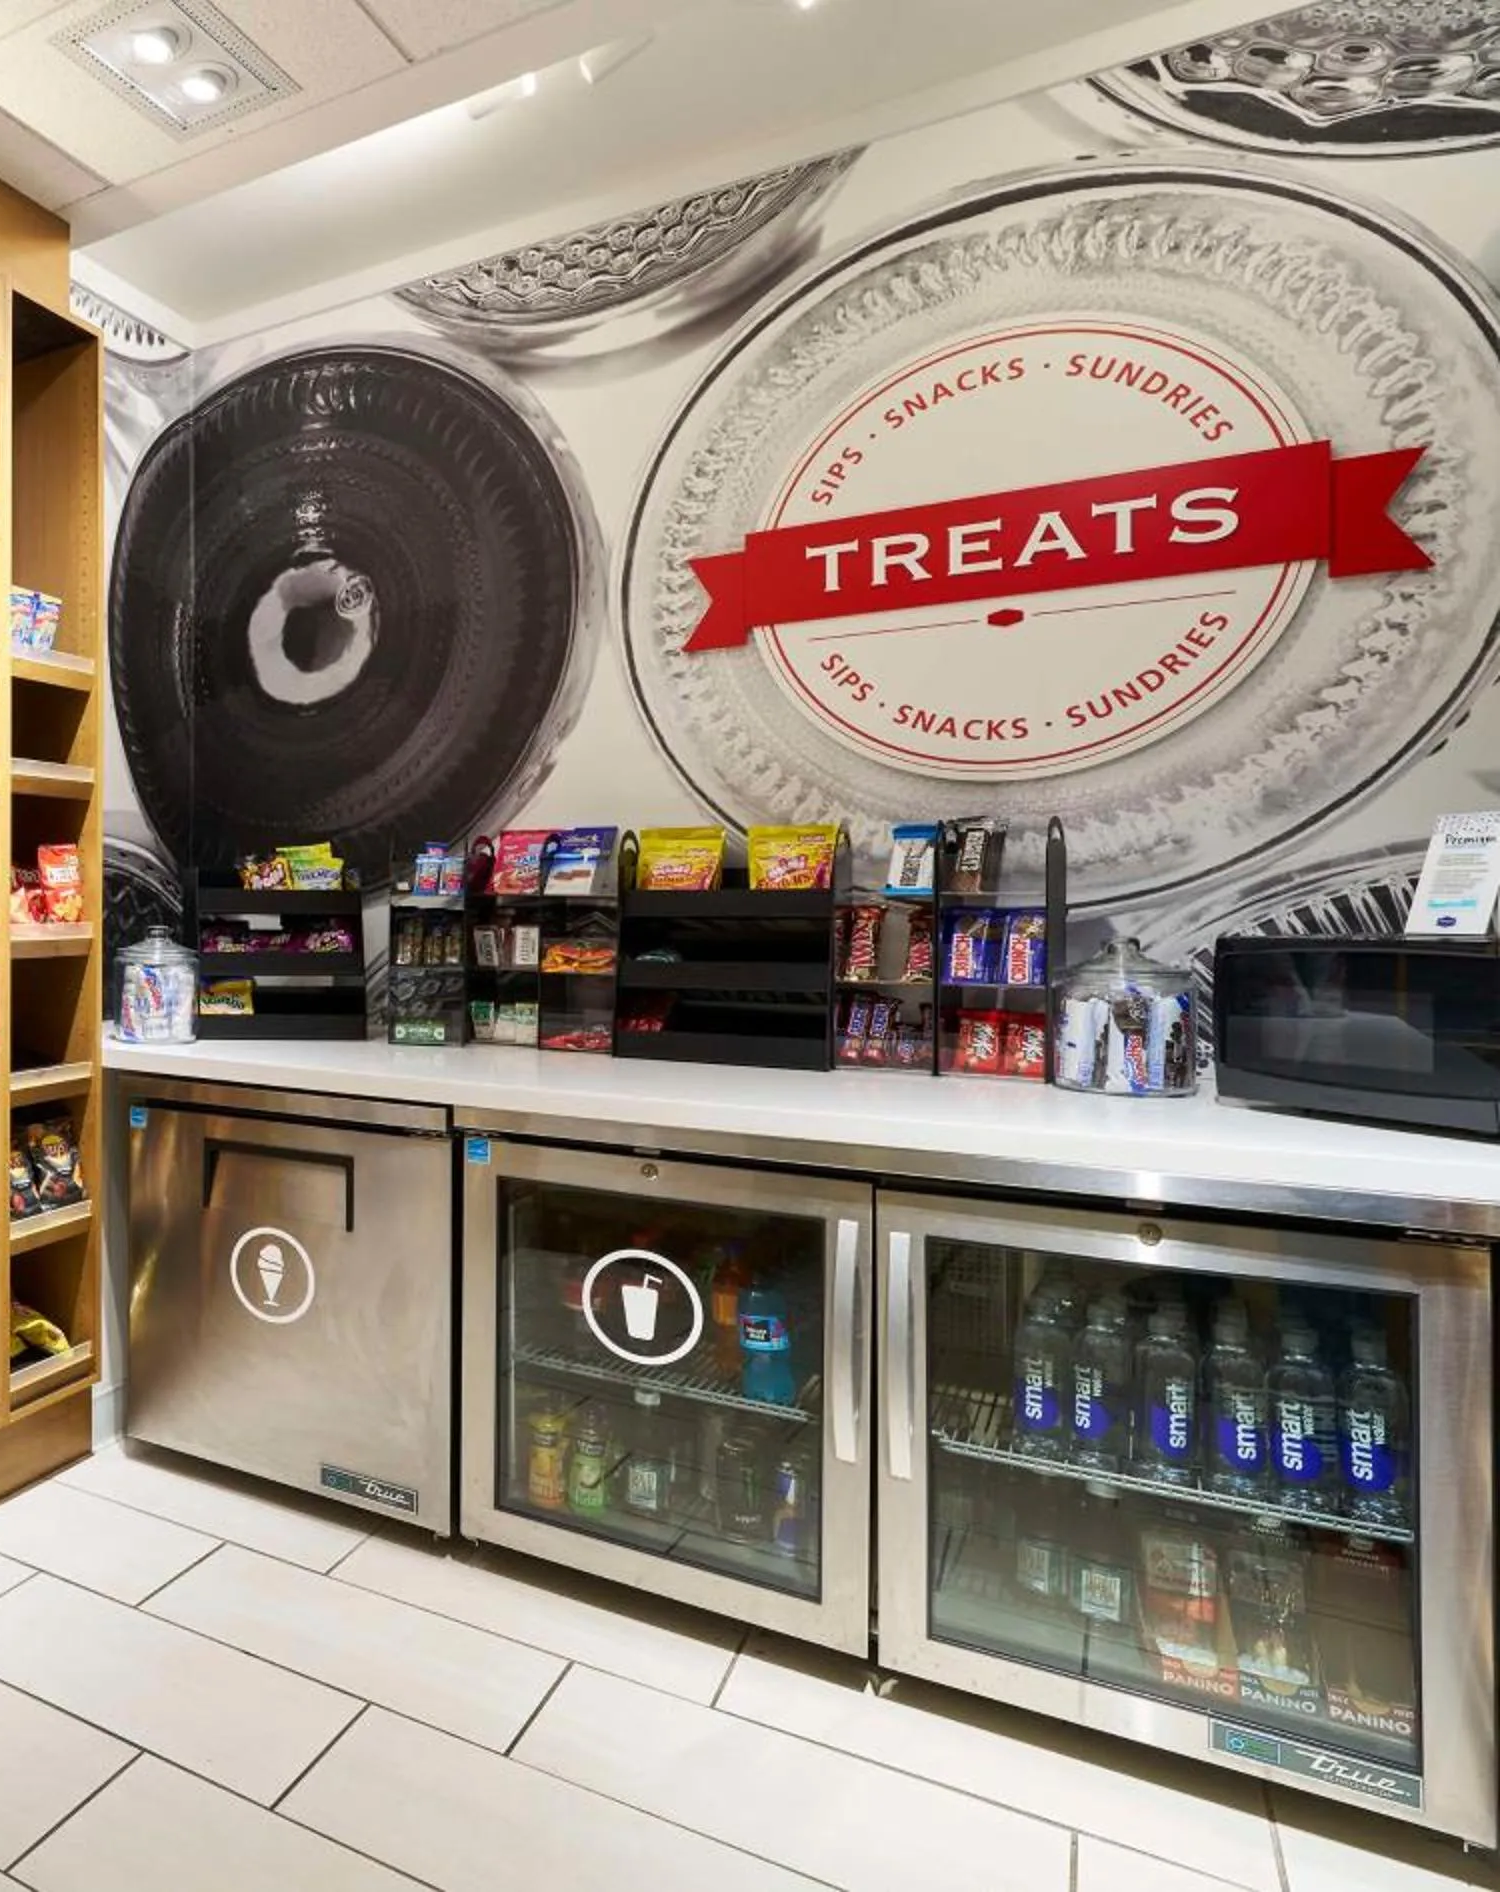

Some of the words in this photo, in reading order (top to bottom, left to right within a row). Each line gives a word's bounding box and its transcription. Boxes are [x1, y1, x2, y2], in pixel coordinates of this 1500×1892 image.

[811, 446, 862, 506] SIPS
[884, 355, 1026, 429] SNACKS
[1064, 352, 1234, 444] SUNDRIES
[805, 487, 1240, 594] TREATS
[820, 652, 875, 703] SIPS
[893, 704, 1029, 740] SNACKS
[1066, 608, 1229, 727] SUNDRIES
[1024, 1357, 1043, 1420] smart
[1074, 1362, 1092, 1430] smart
[1165, 1375, 1188, 1450] smart
[1232, 1391, 1257, 1462] smart
[1276, 1398, 1303, 1472] smart
[1346, 1407, 1374, 1482] smart
[1163, 1669, 1236, 1697] PANINO
[1240, 1687, 1318, 1714] PANINO
[1327, 1705, 1414, 1736] PANINO
